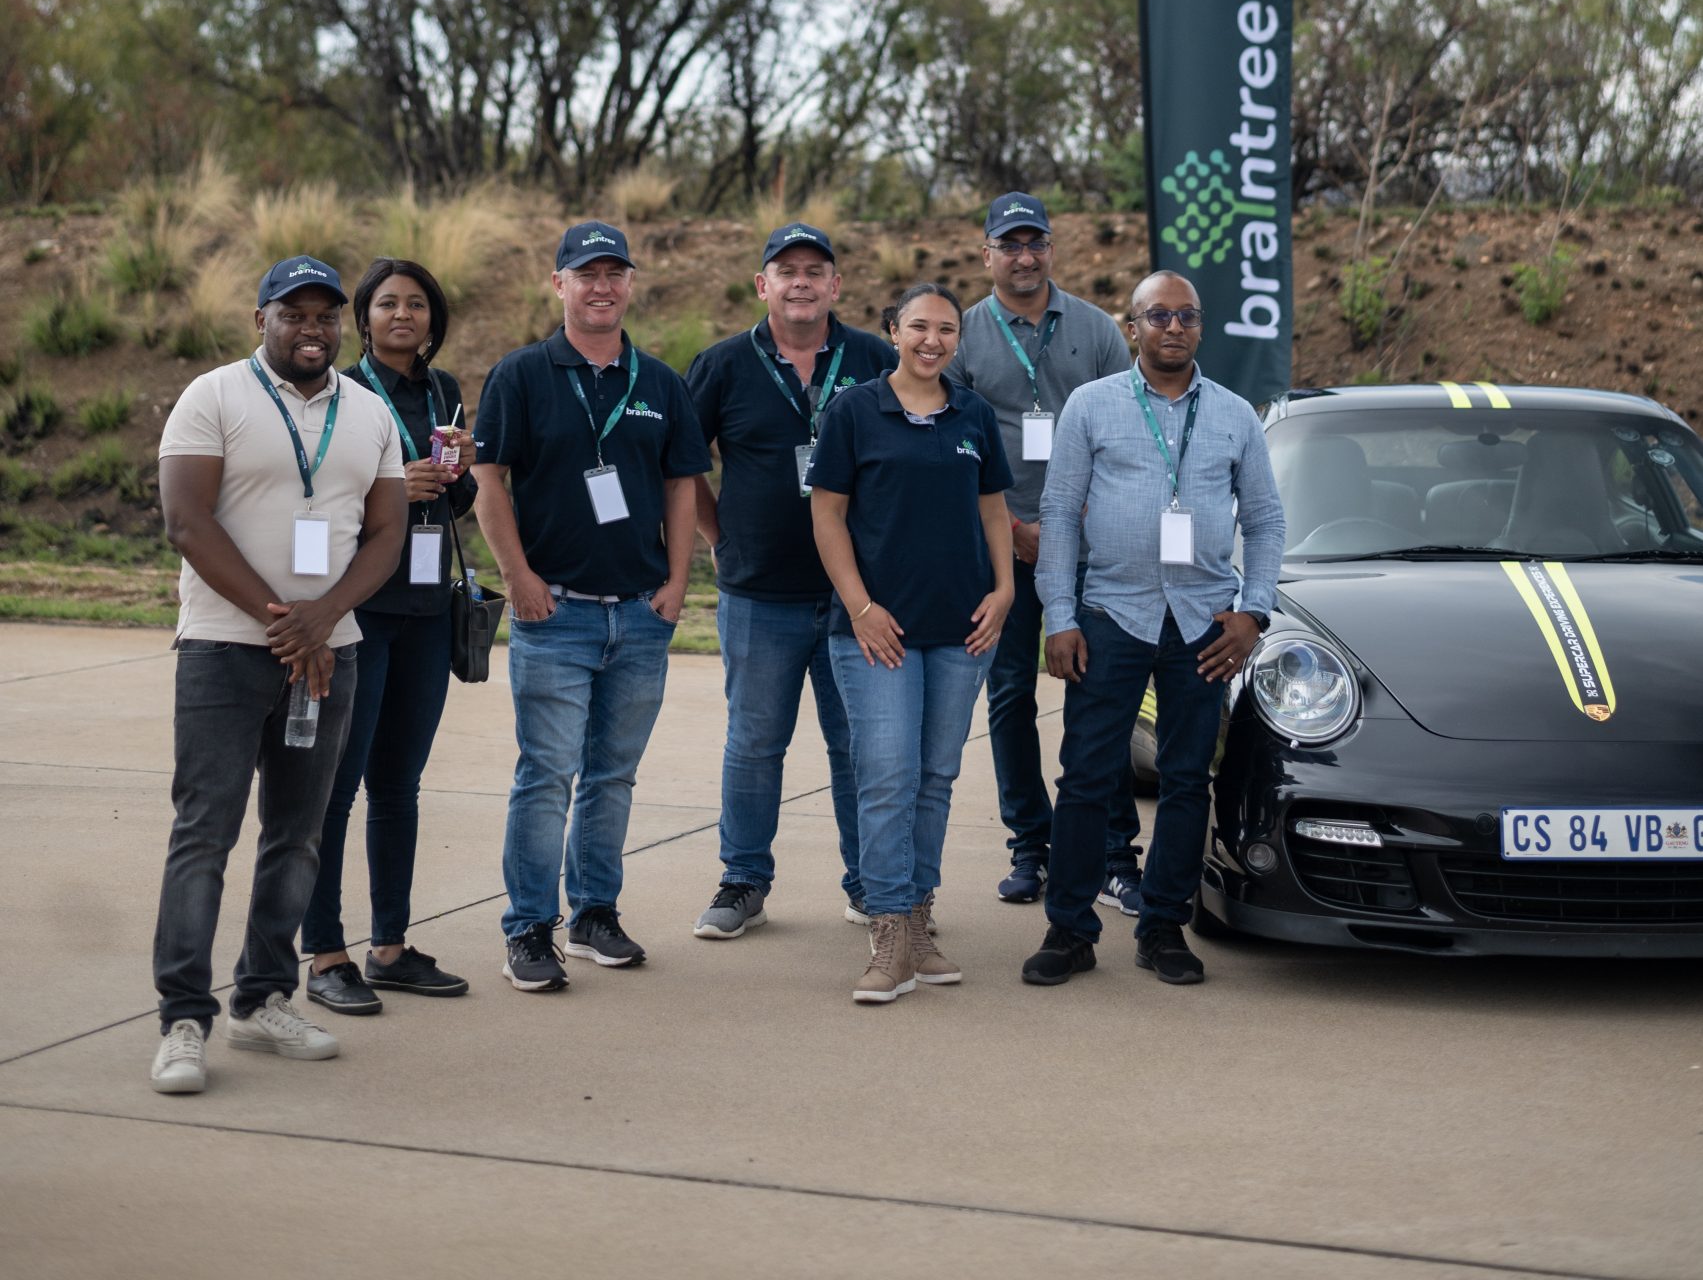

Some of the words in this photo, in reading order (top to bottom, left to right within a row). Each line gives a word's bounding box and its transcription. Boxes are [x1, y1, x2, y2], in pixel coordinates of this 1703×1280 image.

[1224, 0, 1281, 340] braintree
[626, 407, 663, 420] braintree
[1531, 570, 1562, 609] EXPERIENCES
[1552, 609, 1577, 638] DRIVING
[1566, 638, 1597, 689] SUPERCAR
[1512, 815, 1552, 852] CS
[1569, 815, 1608, 852] 84
[1624, 815, 1664, 852] VB
